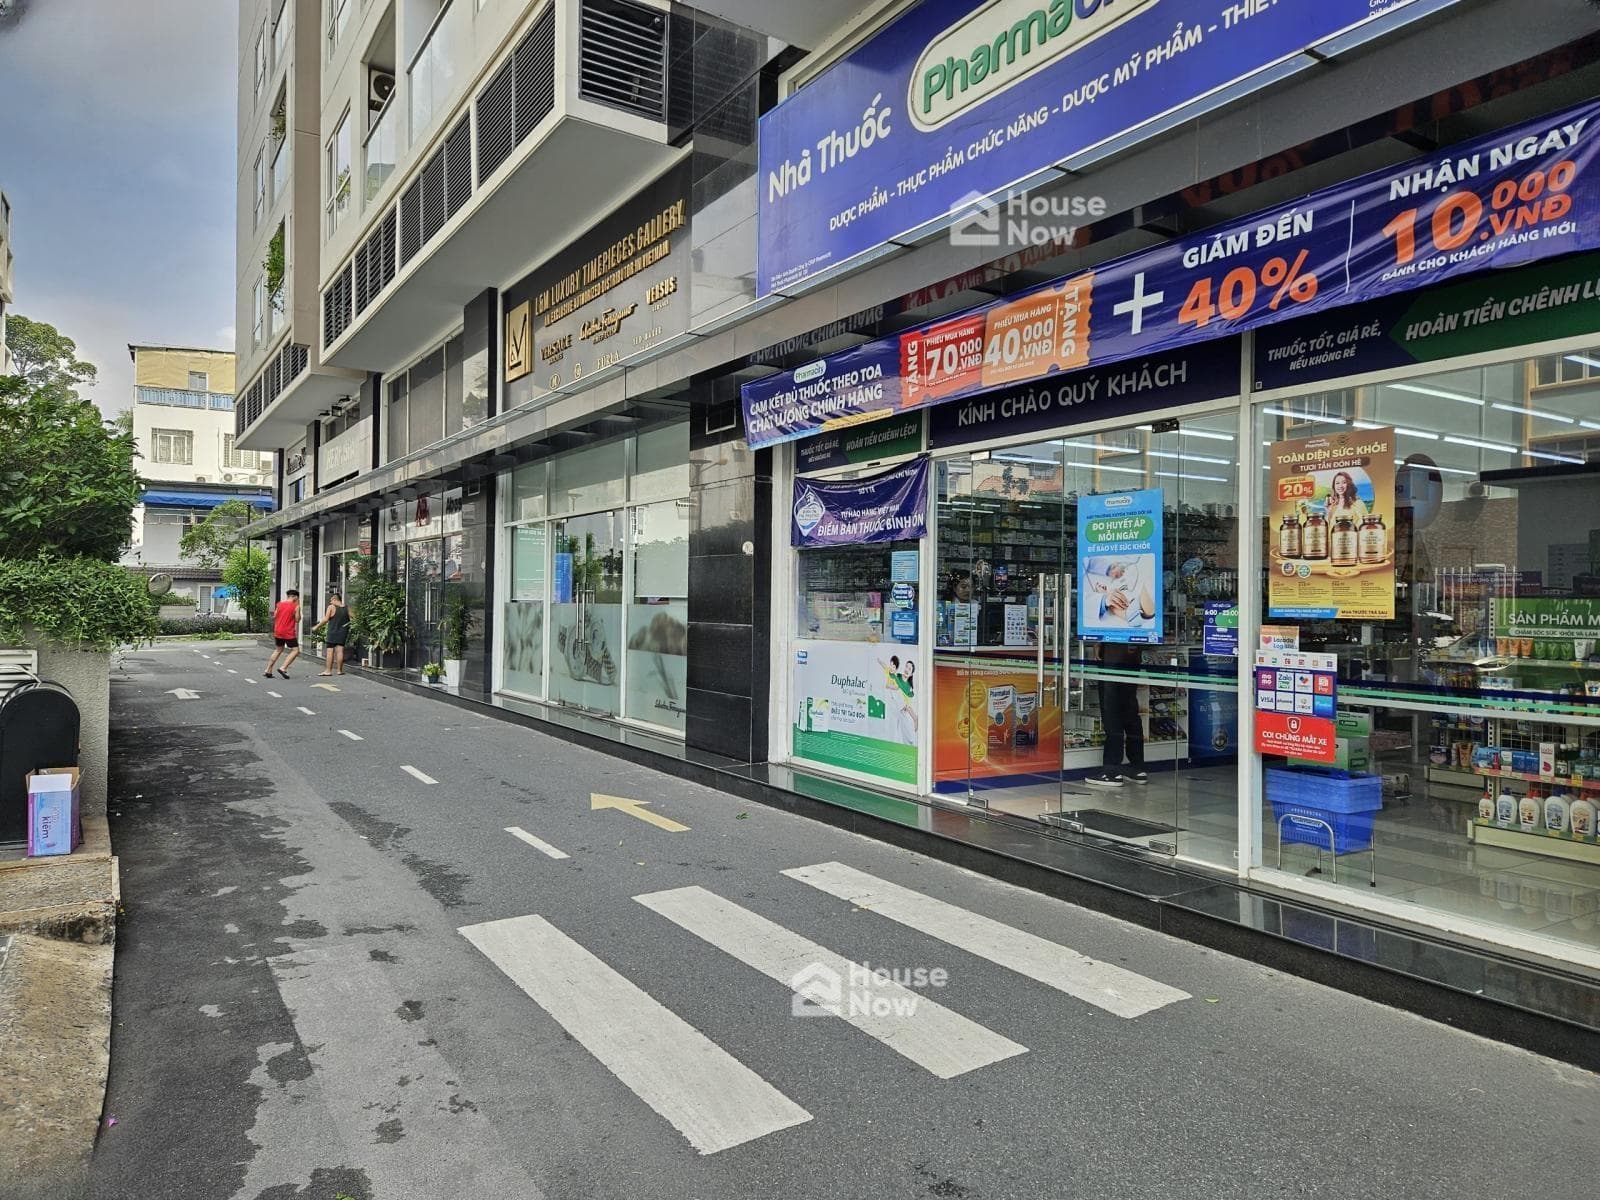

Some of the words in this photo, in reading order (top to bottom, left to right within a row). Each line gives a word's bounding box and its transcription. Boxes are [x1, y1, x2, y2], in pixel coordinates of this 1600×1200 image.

[830, 207, 857, 231] DƯỢC
[858, 186, 888, 217] PHẨM
[897, 170, 926, 196] THỰC
[929, 146, 964, 180] PHẨM
[967, 129, 1004, 160] CHỨC
[1007, 107, 1048, 141] NĂNG
[1062, 74, 1109, 113] DƯỢC
[1113, 52, 1142, 87] MỸ
[1145, 21, 1202, 70] PHẨM
[769, 149, 811, 203] Nhà
[817, 92, 891, 173] Thuốc
[1389, 154, 1480, 201] NHẬN
[1489, 118, 1588, 171] NGAY
[1491, 160, 1576, 210] 000
[1182, 232, 1249, 269] GIẢM
[1255, 208, 1313, 248] ĐẾN
[1382, 190, 1483, 265] 10
[1417, 256, 1447, 271] CHO
[1449, 241, 1496, 264] KHÁCH
[1498, 230, 1539, 249] HÀNG
[1543, 221, 1576, 238] MỚI
[551, 269, 580, 306] LUXURY
[582, 232, 635, 286] TIMEPIECES
[637, 198, 687, 250] GALLERY
[1177, 249, 1318, 328] 40%
[994, 316, 1013, 331] PHIẾU
[1013, 311, 1029, 325] MUA
[1030, 303, 1052, 318] HÀNG
[1023, 318, 1053, 342] 000
[1061, 287, 1081, 358] TẶNG
[1406, 312, 1459, 342] HOÀN
[1462, 295, 1505, 328] TIỀN
[1507, 285, 1582, 316] CHÊNH
[926, 333, 944, 347] PHIẾU
[944, 331, 957, 343] MUA
[958, 327, 975, 340] HÀNG
[960, 337, 982, 354] 000
[984, 328, 1020, 367] 40
[1267, 336, 1306, 362] THUỐC
[1309, 330, 1334, 353] TỐT,
[1337, 325, 1359, 345] GIÁ
[906, 339, 921, 397] TẶNG
[926, 343, 959, 381] 70
[1289, 353, 1308, 371] NẾU
[1309, 350, 1341, 367] KHÔNG
[1342, 345, 1356, 359] RẺ
[750, 399, 768, 416] CAM
[768, 389, 785, 411] KẾT
[785, 385, 798, 406] ĐỦ
[799, 376, 831, 400] THUỐC
[832, 373, 859, 391] THEO
[860, 363, 883, 381] TOA
[958, 403, 995, 427] KÍNH
[1001, 389, 1051, 418] CHÀO
[1058, 375, 1100, 406] QUÝ
[1107, 360, 1187, 397] KHÁCH
[750, 408, 774, 433] CHẤT
[774, 408, 809, 430] LƯỢNG
[811, 394, 847, 416] CHÍNH
[1277, 450, 1305, 464] TOÀN
[1306, 448, 1331, 462] DIỆN
[1332, 445, 1354, 458] SỨC
[1356, 441, 1388, 455] KHỎE
[1300, 463, 1317, 472] TƯƠI
[1333, 459, 1350, 469] ĐÓN
[1283, 483, 1313, 496] 20%
[817, 522, 839, 536] ĐIỂM
[840, 521, 858, 535] BÁN
[859, 516, 885, 534] THUỐC
[886, 516, 911, 531] BÌNH
[1092, 522, 1105, 531] ĐO
[1106, 518, 1133, 530] HUYẾT
[1134, 517, 1146, 528] ÁP
[1116, 530, 1140, 541] NGÀY
[1119, 542, 1132, 551] SỨC
[1508, 610, 1536, 625] SẢN
[1540, 608, 1585, 626] PHẨM
[831, 674, 866, 689] Duphalac
[1262, 730, 1274, 739] COI
[1318, 738, 1327, 746] XE
